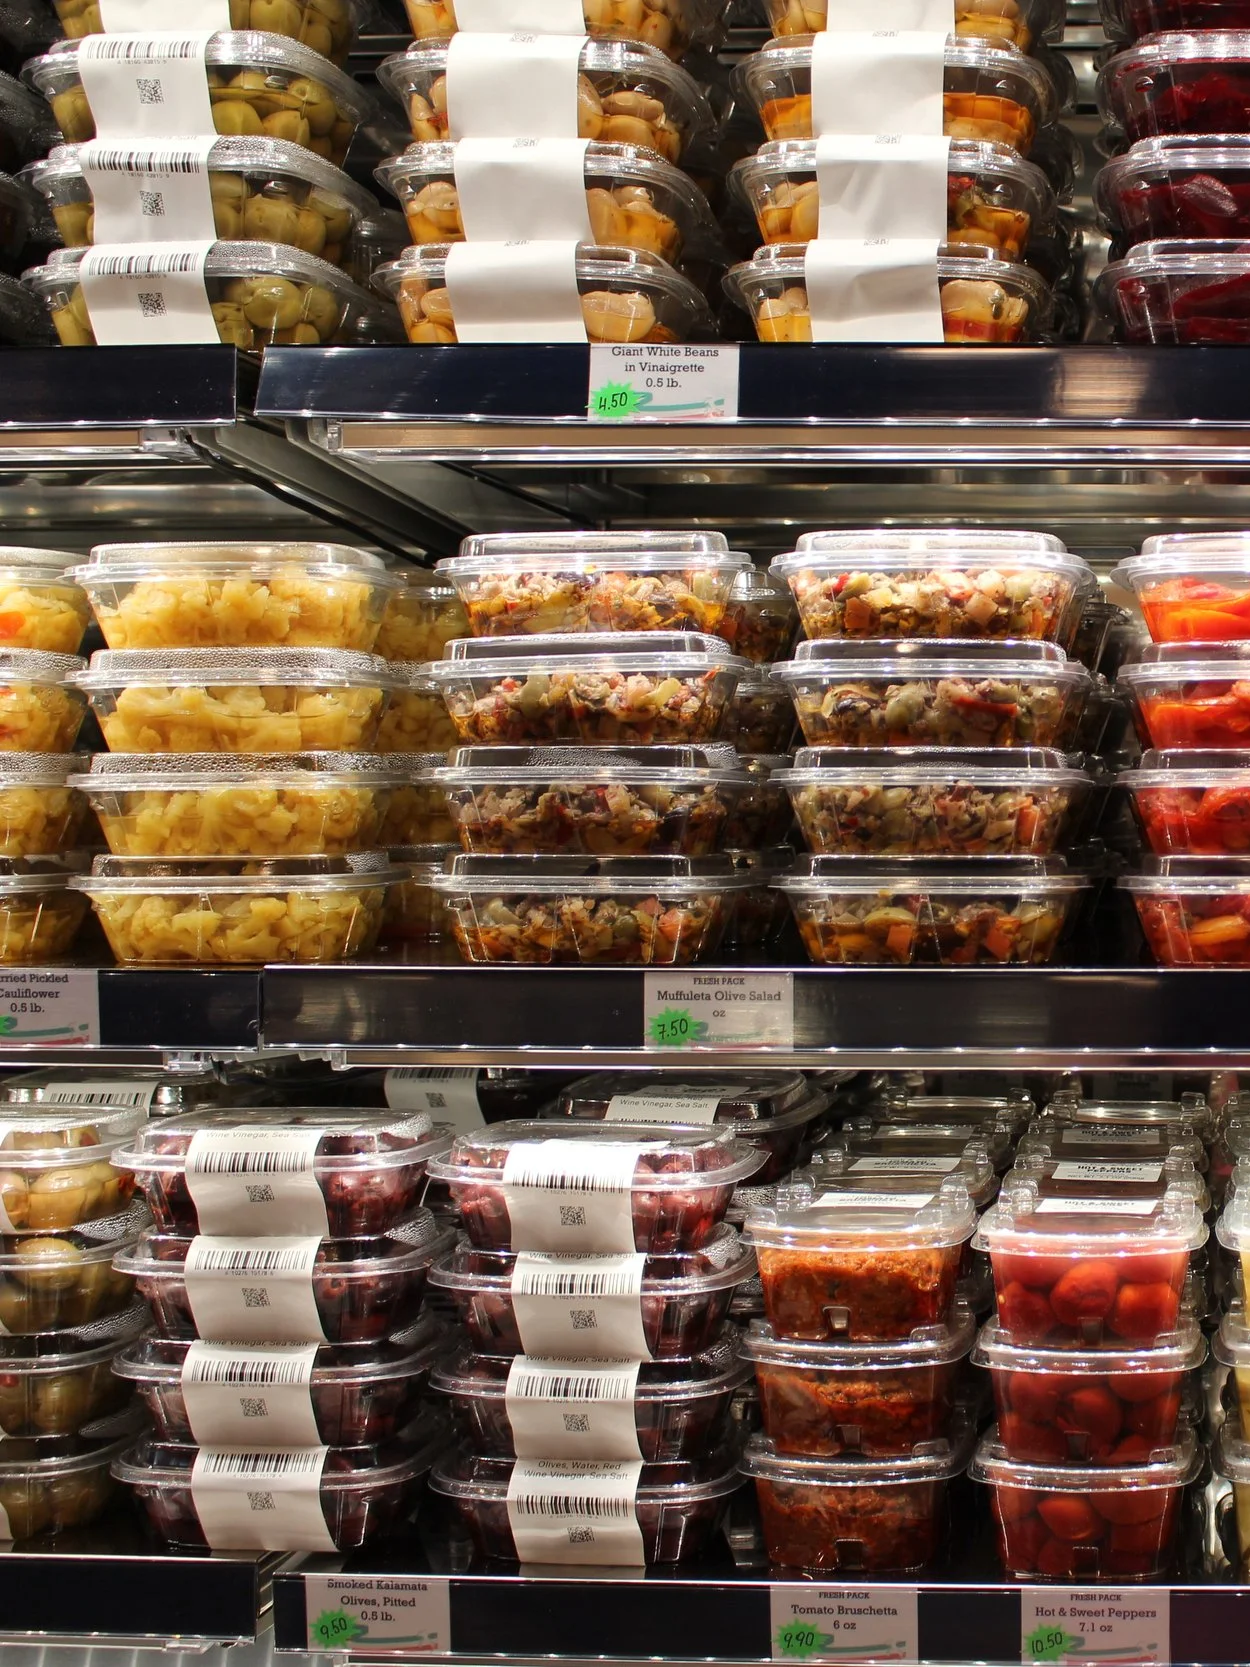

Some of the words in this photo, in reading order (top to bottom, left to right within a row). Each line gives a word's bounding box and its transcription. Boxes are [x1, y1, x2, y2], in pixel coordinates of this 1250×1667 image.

[612, 347, 643, 357] Giant
[647, 347, 681, 357] White
[684, 347, 719, 357] Beans
[625, 363, 636, 372] in
[638, 363, 704, 374] Vinaigrette
[646, 378, 663, 387] 0.5
[666, 378, 681, 387] lb.
[599, 392, 628, 410] 4.50
[29, 974, 68, 983] Pickled
[693, 977, 716, 985] FRESH
[719, 977, 744, 985] PACK
[0, 988, 59, 999] Cauliflower
[657, 991, 711, 1001] Muffuleta
[715, 991, 746, 1001] Olive
[749, 991, 781, 1001] Salad
[10, 1003, 28, 1012] 0.5
[31, 1003, 44, 1012] lb.
[713, 1009, 725, 1017] oz
[657, 1019, 688, 1040] 7.50
[642, 1099, 673, 1108] Vinegar,
[538, 1461, 570, 1470] Olives,
[572, 1462, 601, 1470] Water,
[524, 1470, 547, 1478] Wine
[549, 1471, 587, 1480] Vinegar,
[328, 1579, 372, 1590] Smoked
[376, 1580, 427, 1591] Kalamata
[341, 1596, 380, 1607] Olives,
[383, 1597, 415, 1607] Pitted
[791, 1605, 834, 1615] Tomato
[837, 1605, 897, 1616] Bruschetta
[1036, 1607, 1056, 1617] Hot
[1059, 1607, 1067, 1616] &
[1070, 1607, 1105, 1617] Sweet
[1108, 1607, 1156, 1620] Peppers
[361, 1612, 379, 1621] 0.5
[382, 1612, 395, 1621] lb.
[320, 1618, 348, 1640] 9.50
[833, 1621, 839, 1629] 6
[1080, 1623, 1095, 1632] 7.1
[1100, 1624, 1112, 1632] oz
[783, 1632, 815, 1649] 9.90
[1032, 1632, 1063, 1654] 10.50
